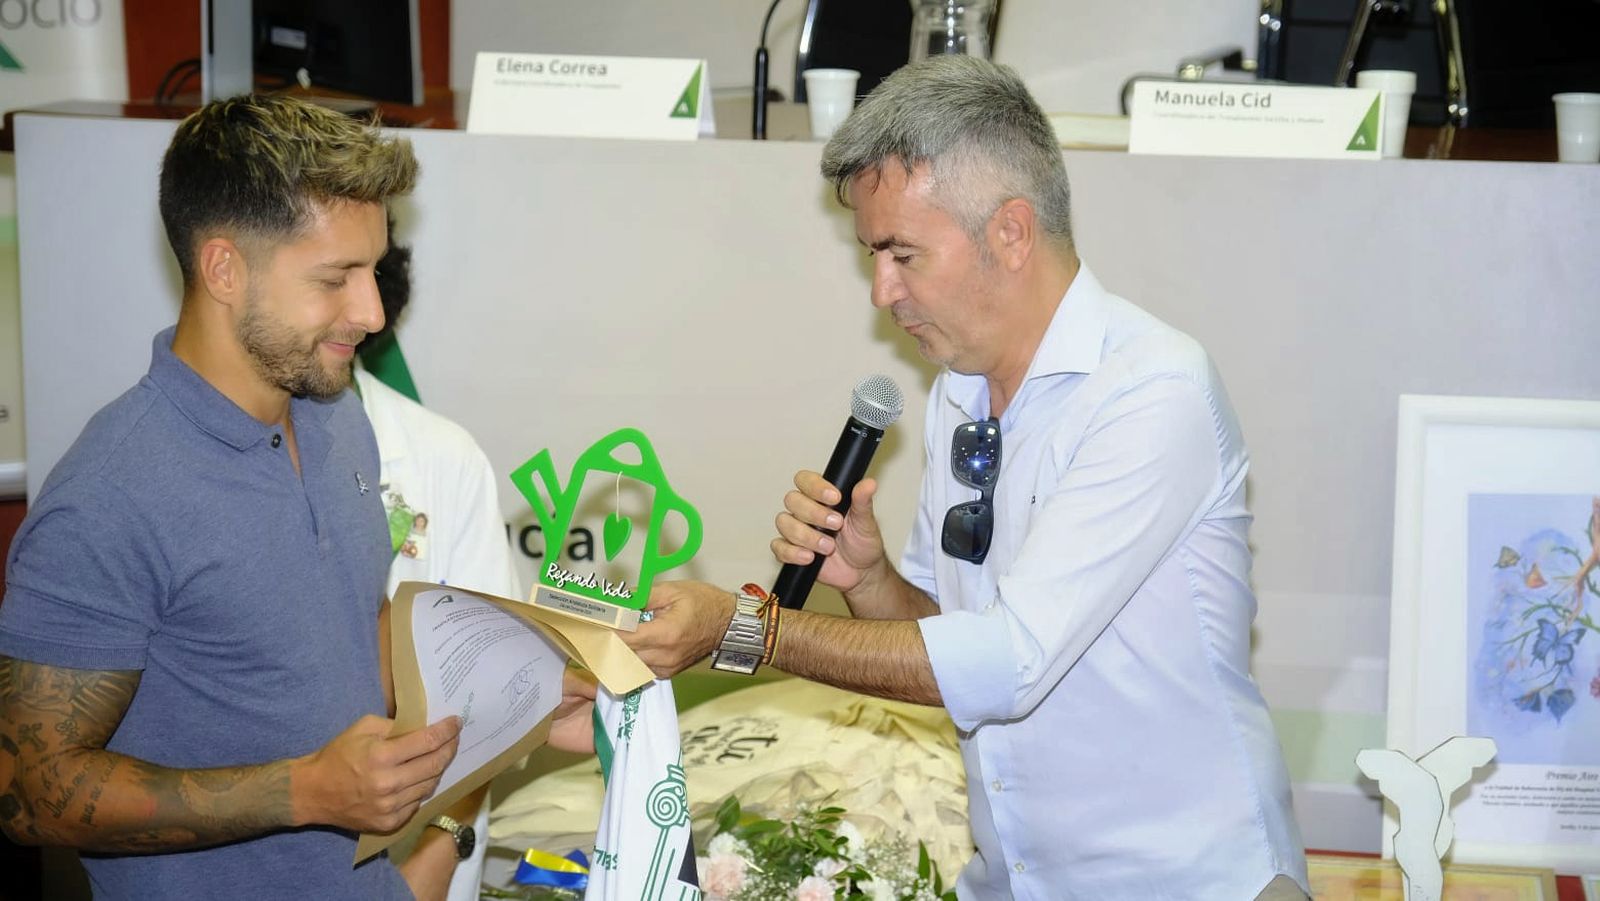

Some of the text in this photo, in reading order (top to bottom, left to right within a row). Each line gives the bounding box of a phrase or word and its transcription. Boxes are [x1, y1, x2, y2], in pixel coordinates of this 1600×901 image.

[496, 58, 608, 76] Elena Correa
[1154, 90, 1272, 108] Manuela Cid
[601, 577, 633, 599] Vida
